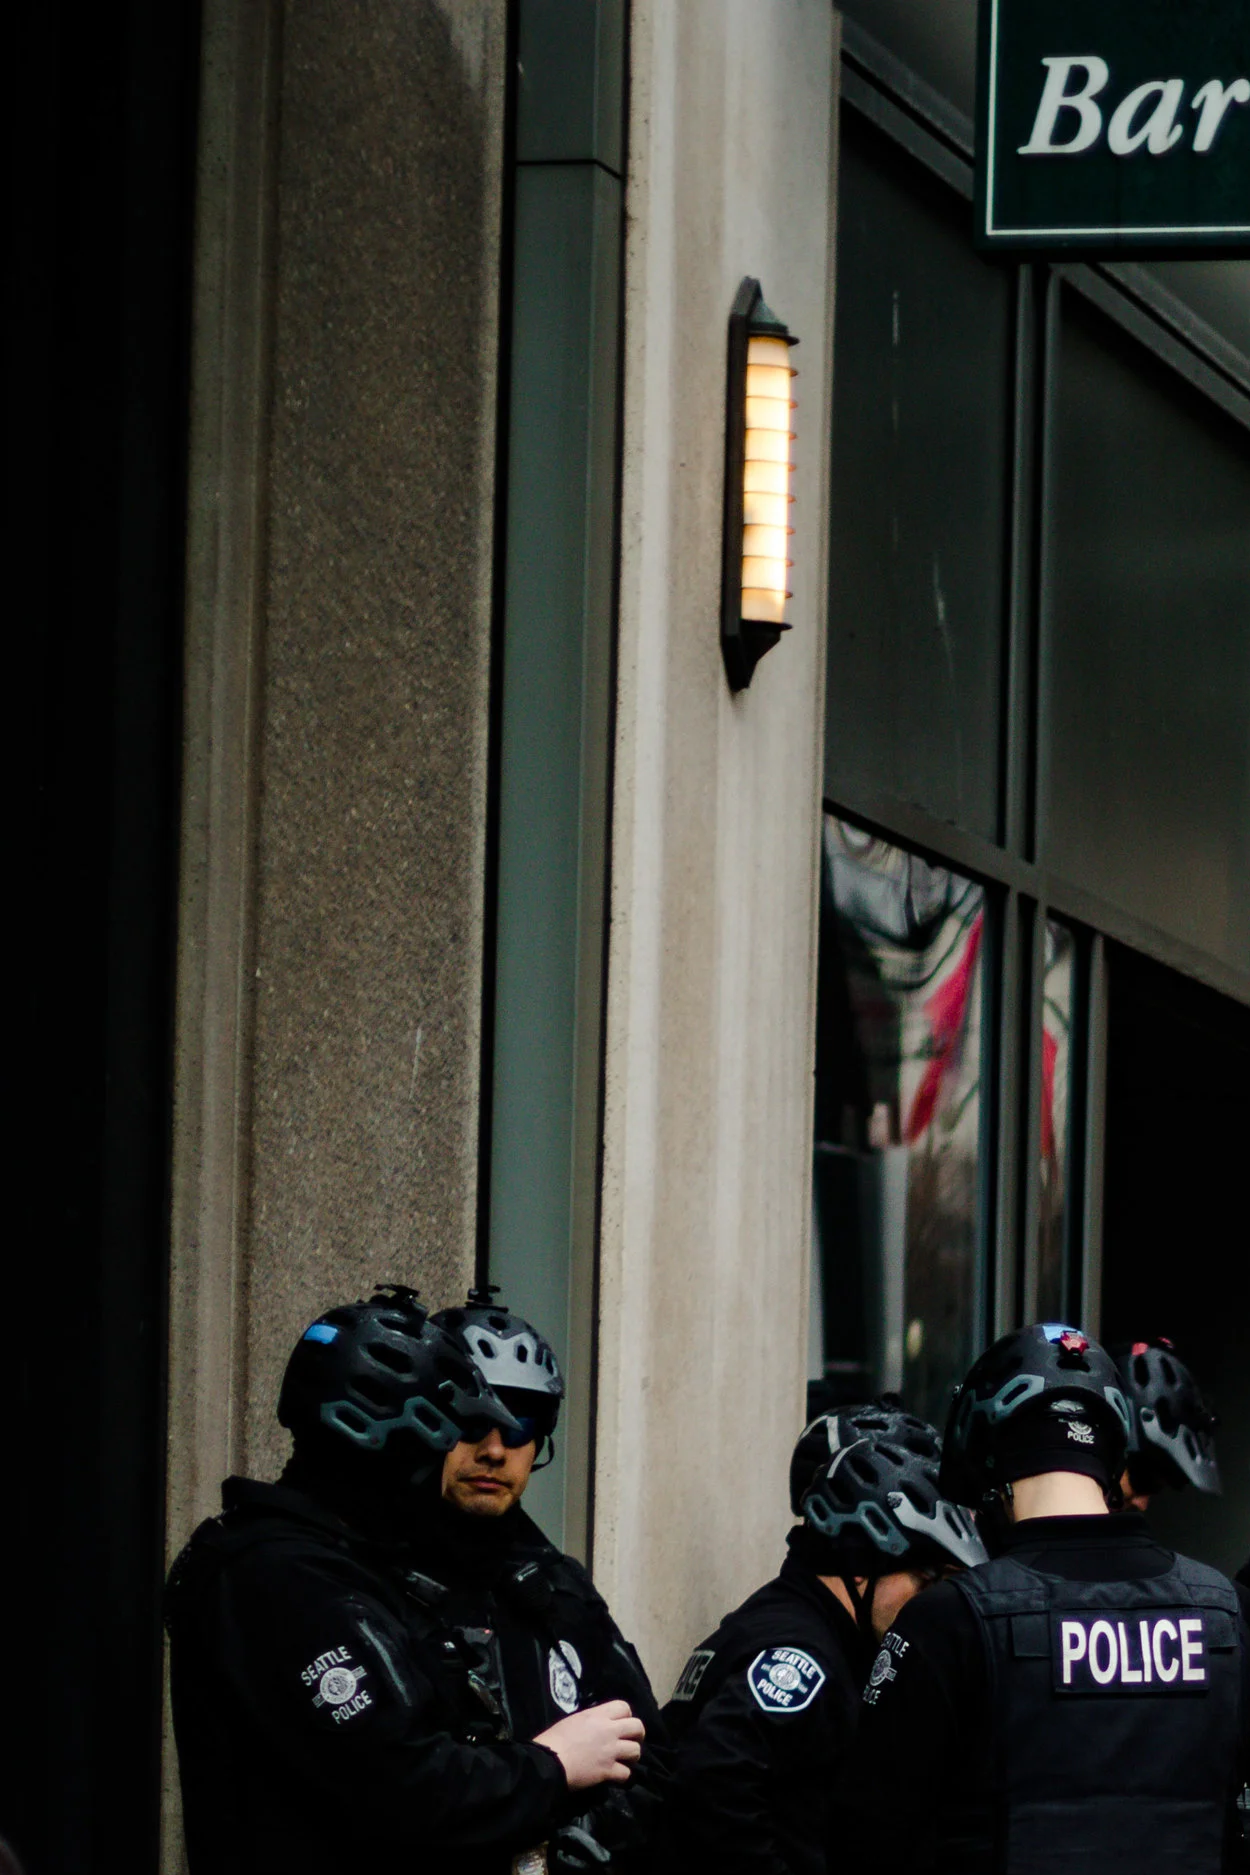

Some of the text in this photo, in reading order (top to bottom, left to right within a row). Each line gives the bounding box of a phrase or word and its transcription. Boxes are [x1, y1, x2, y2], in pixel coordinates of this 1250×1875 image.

[300, 1645, 353, 1687] SEATTLE
[771, 1650, 816, 1680] SEATTLE
[1061, 1618, 1206, 1685] POLICE
[331, 1690, 373, 1725] POLICE
[757, 1681, 794, 1707] POLICE
